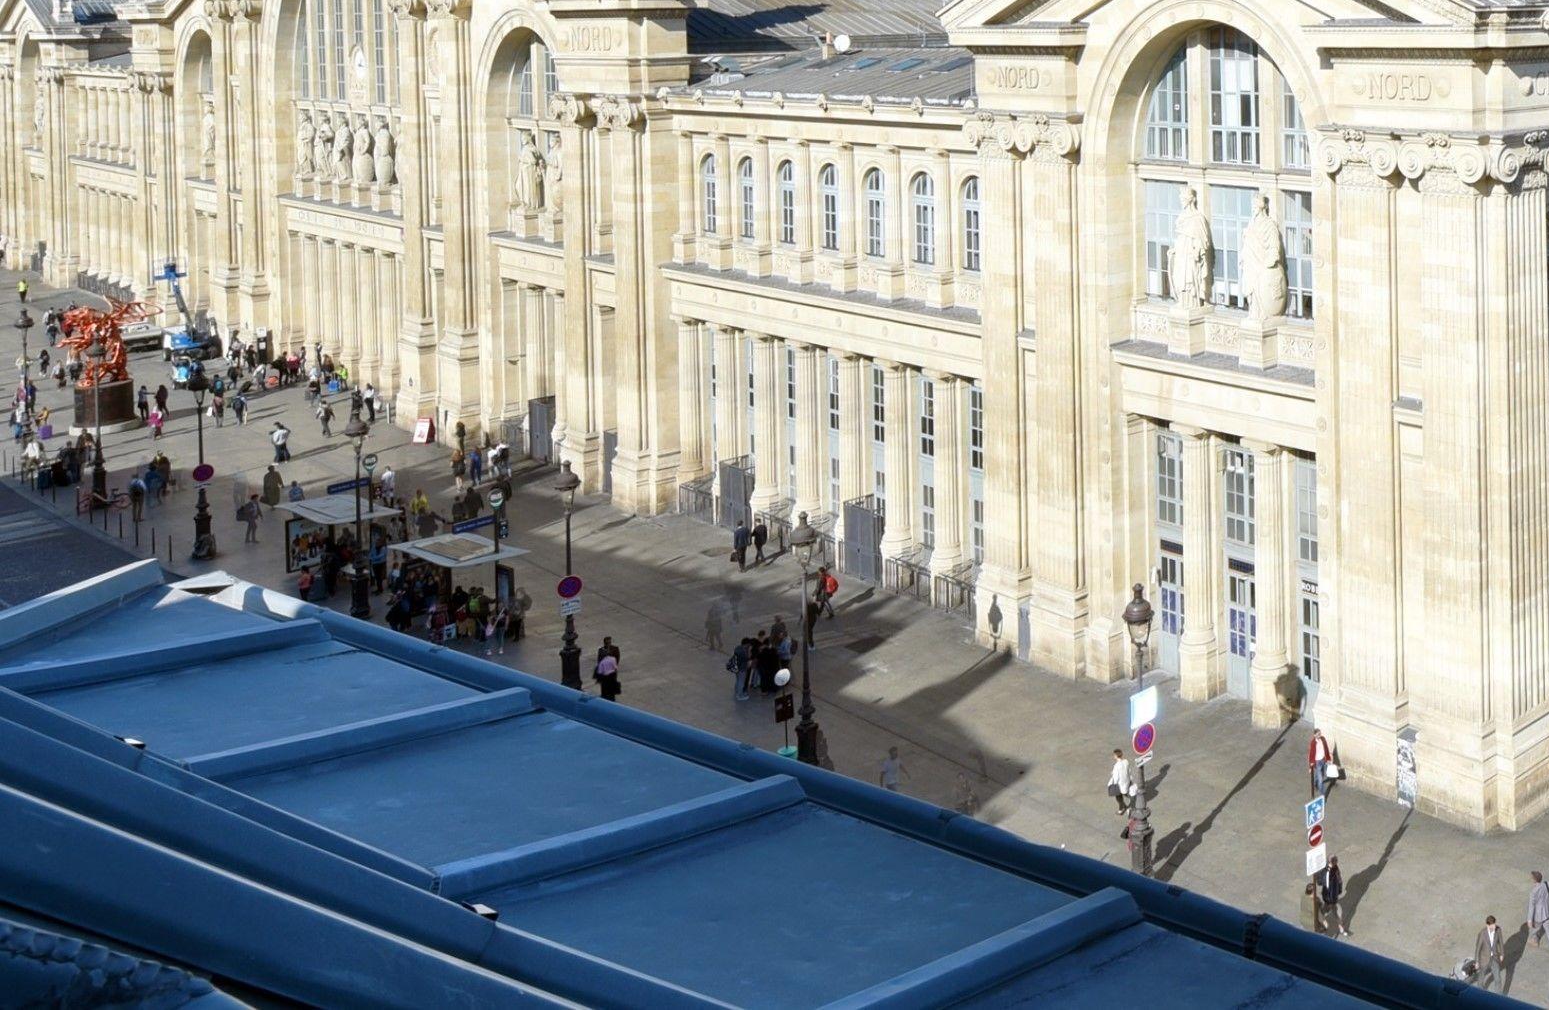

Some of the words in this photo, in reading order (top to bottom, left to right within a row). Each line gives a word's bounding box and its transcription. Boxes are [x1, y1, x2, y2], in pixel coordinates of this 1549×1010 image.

[569, 25, 612, 52] NORD
[998, 66, 1040, 89] NORD
[1367, 72, 1432, 101] NORD
